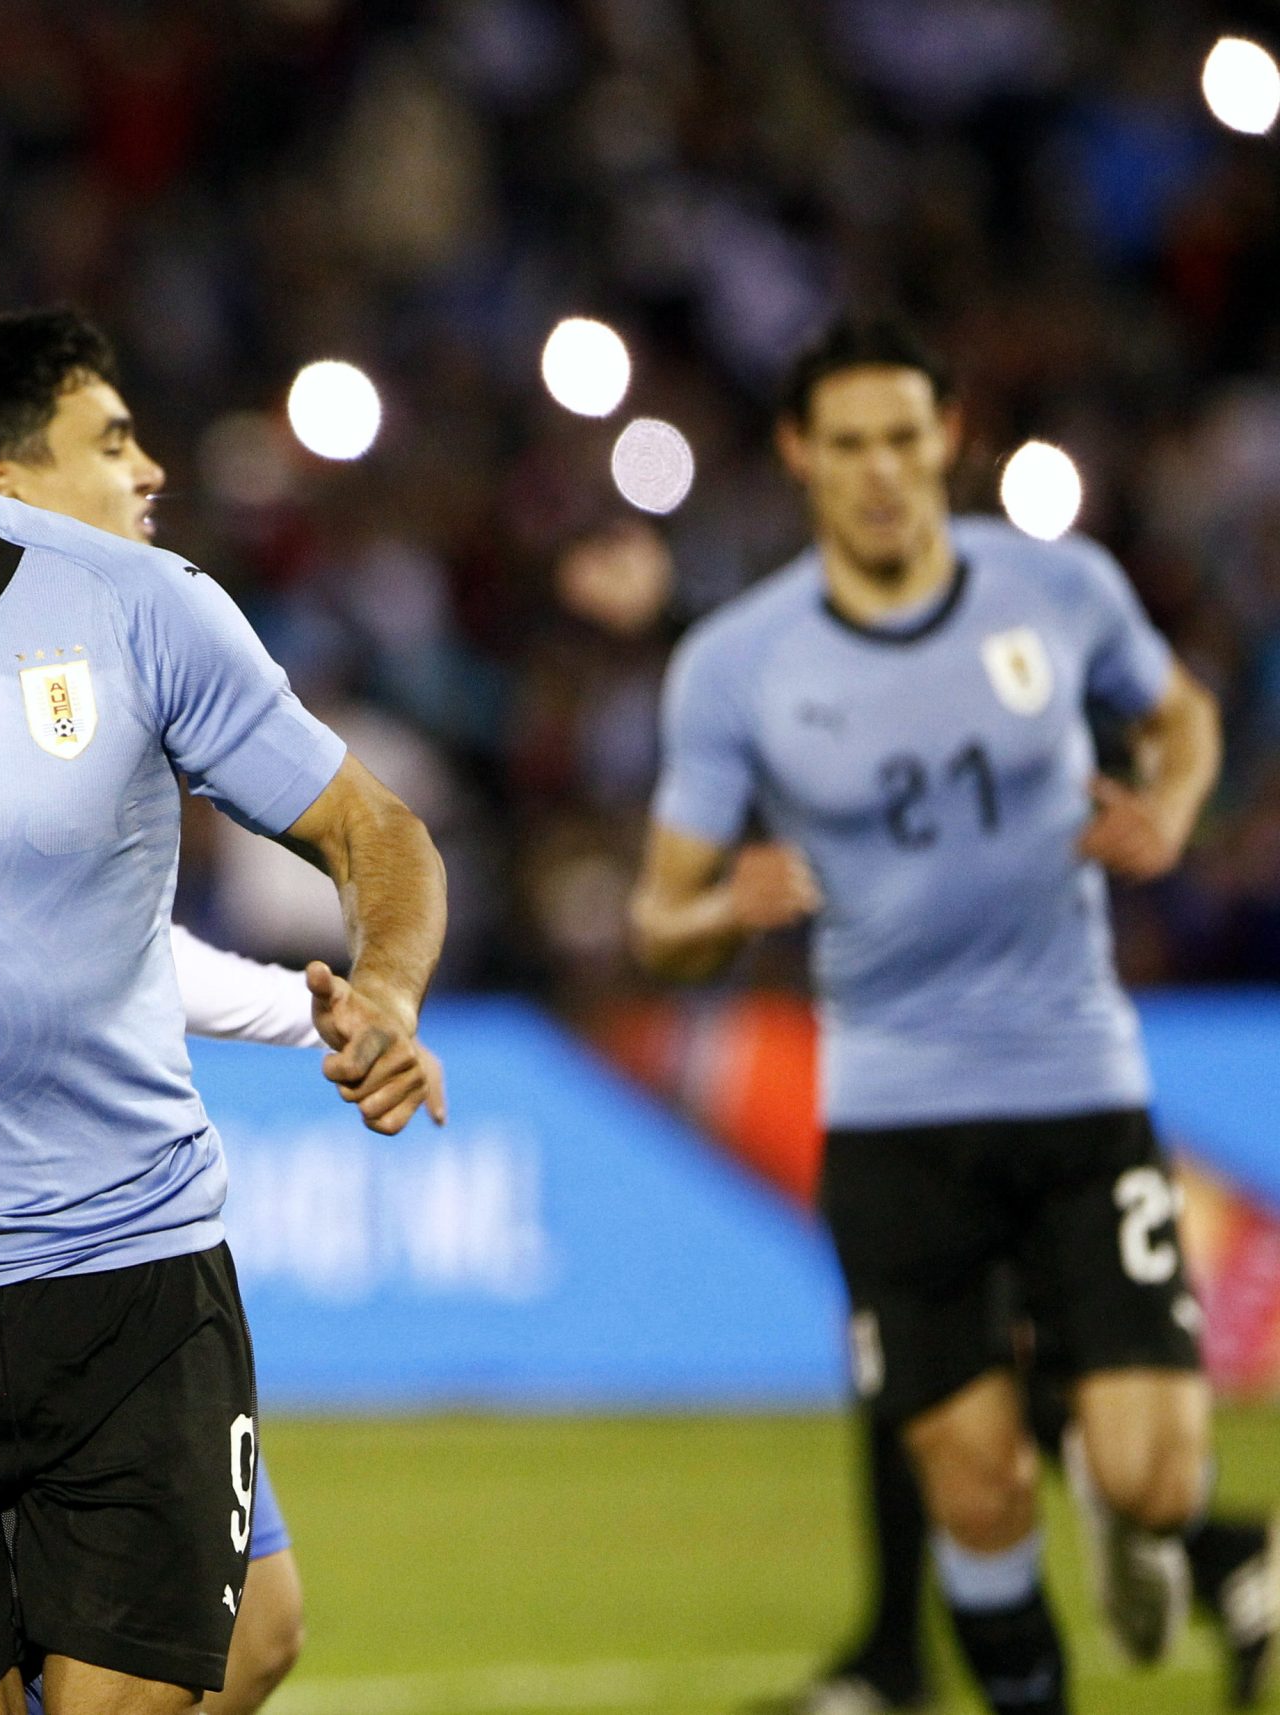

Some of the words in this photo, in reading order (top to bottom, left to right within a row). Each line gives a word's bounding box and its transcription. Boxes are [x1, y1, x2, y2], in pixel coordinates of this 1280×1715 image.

[50, 681, 70, 716] AUF
[878, 738, 1002, 852] 21
[1113, 1165, 1185, 1286] 2
[229, 1413, 257, 1554] 9
